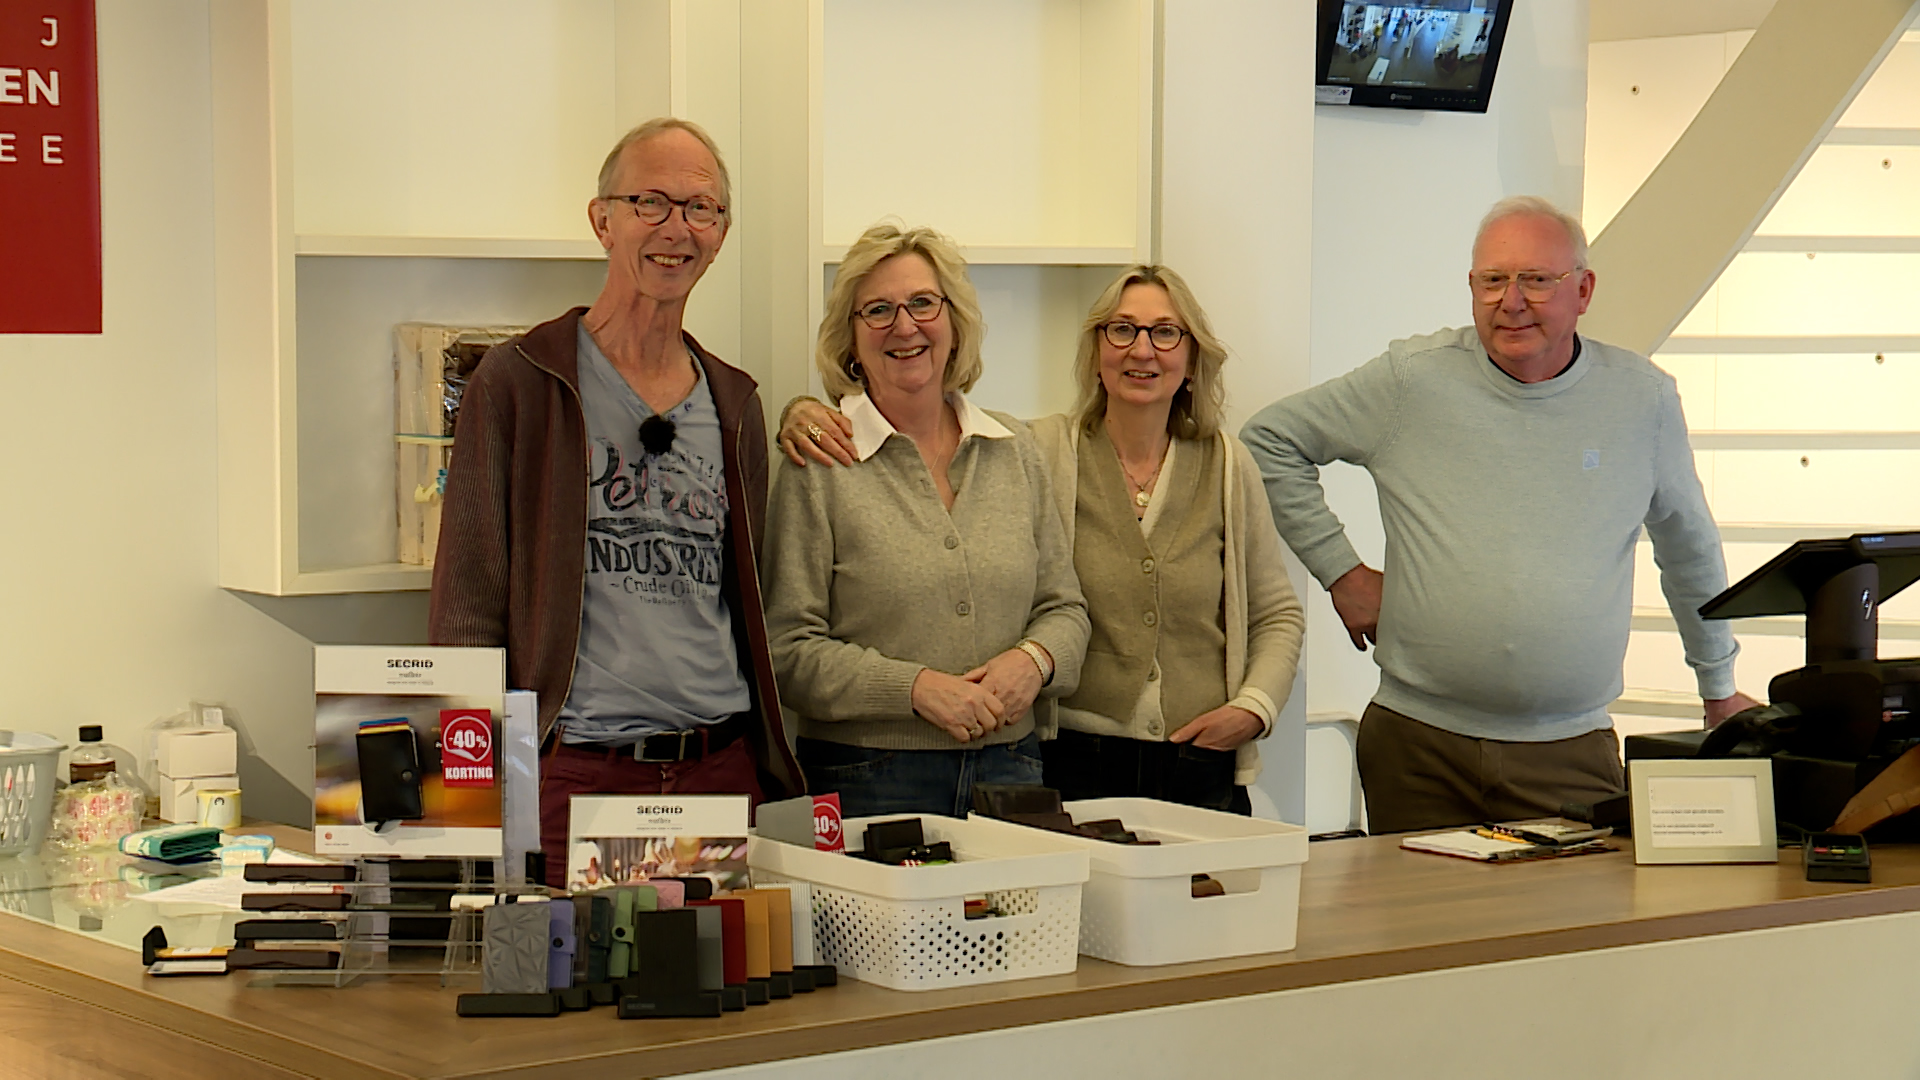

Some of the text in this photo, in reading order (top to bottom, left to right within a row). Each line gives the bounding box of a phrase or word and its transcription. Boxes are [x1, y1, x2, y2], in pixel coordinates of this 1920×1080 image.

[386, 659, 434, 668] SECRID
[448, 729, 487, 749] -40%
[445, 766, 493, 780] KORTING
